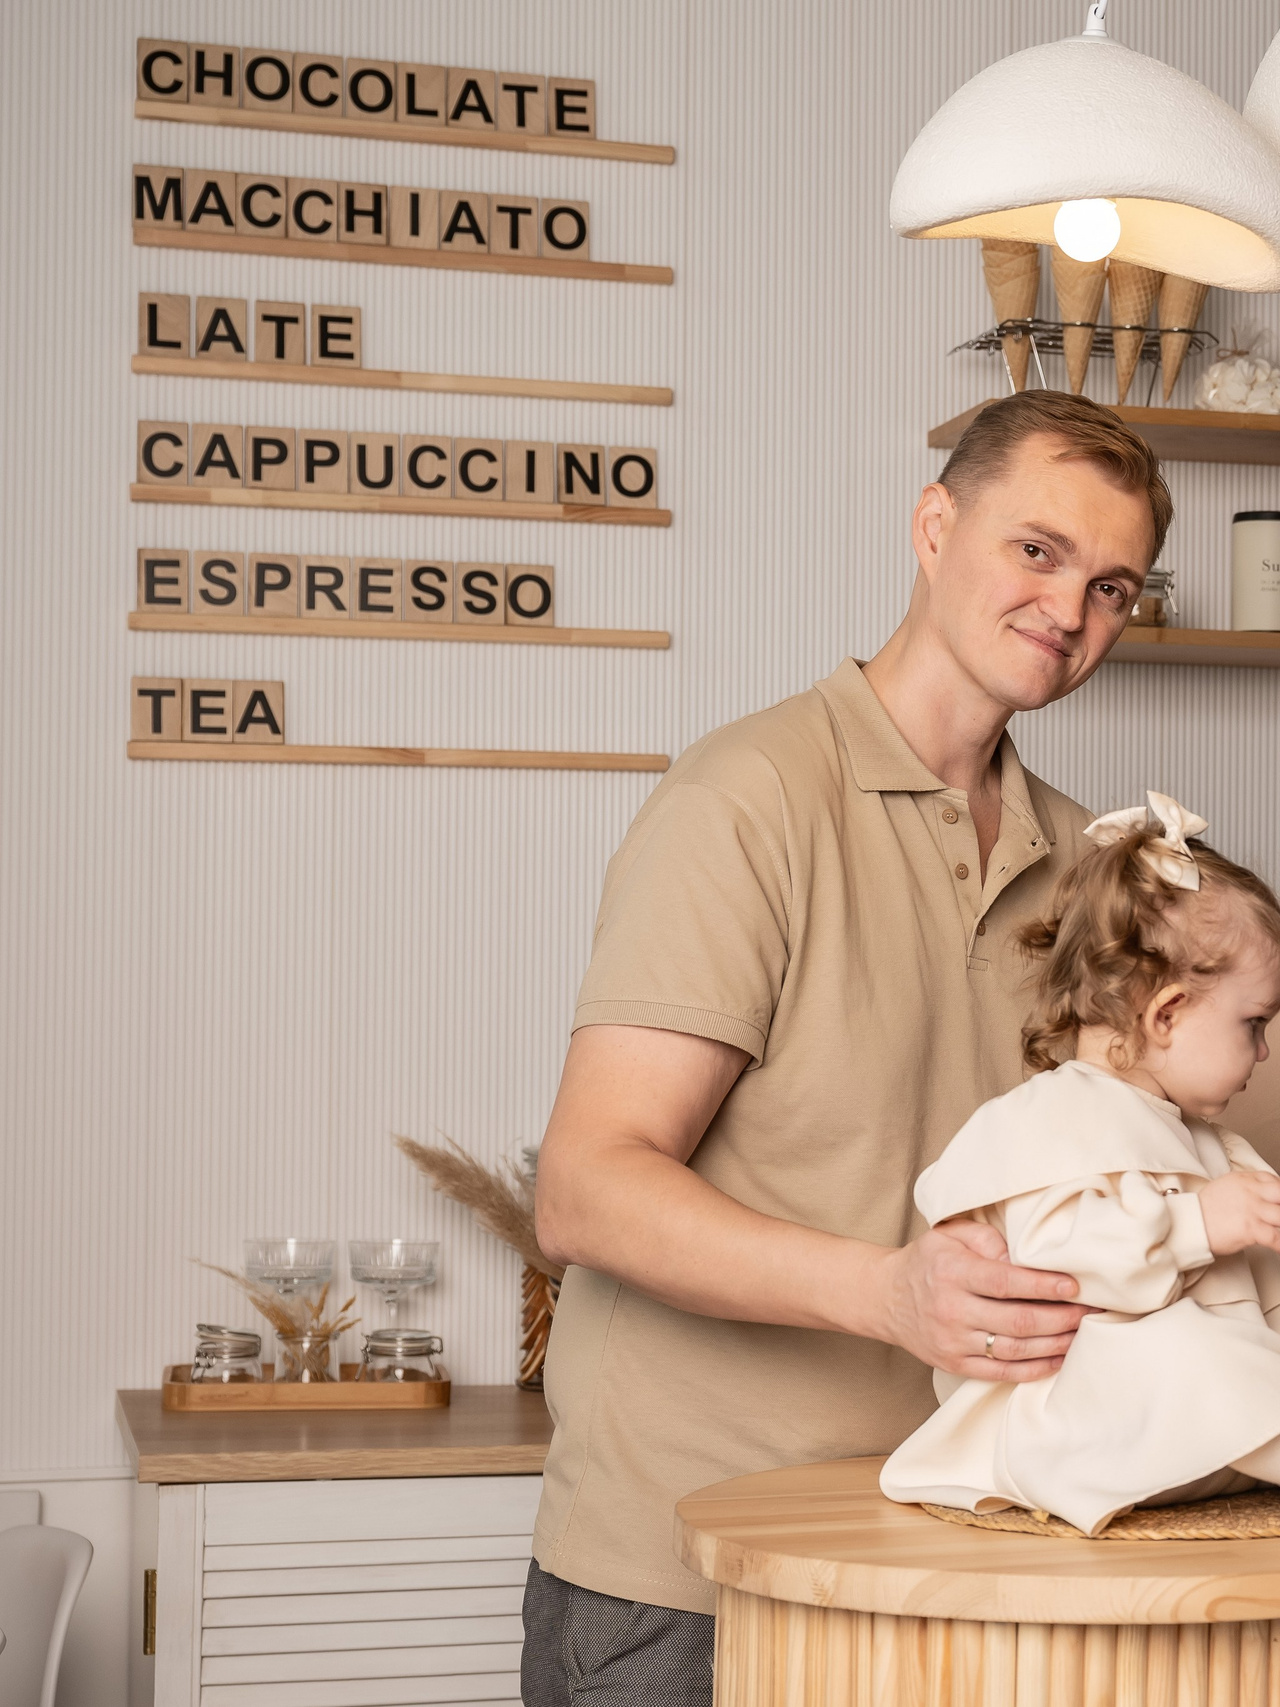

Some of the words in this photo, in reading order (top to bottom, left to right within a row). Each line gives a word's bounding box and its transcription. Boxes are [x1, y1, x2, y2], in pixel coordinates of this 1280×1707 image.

[141, 49, 590, 133] CHOCOLATE
[134, 175, 587, 251] MACCHIATO
[147, 303, 355, 360] LATE
[142, 432, 654, 498] CAPPUCCINO
[145, 559, 552, 619] ESPRESSO
[138, 689, 282, 735] TEA
